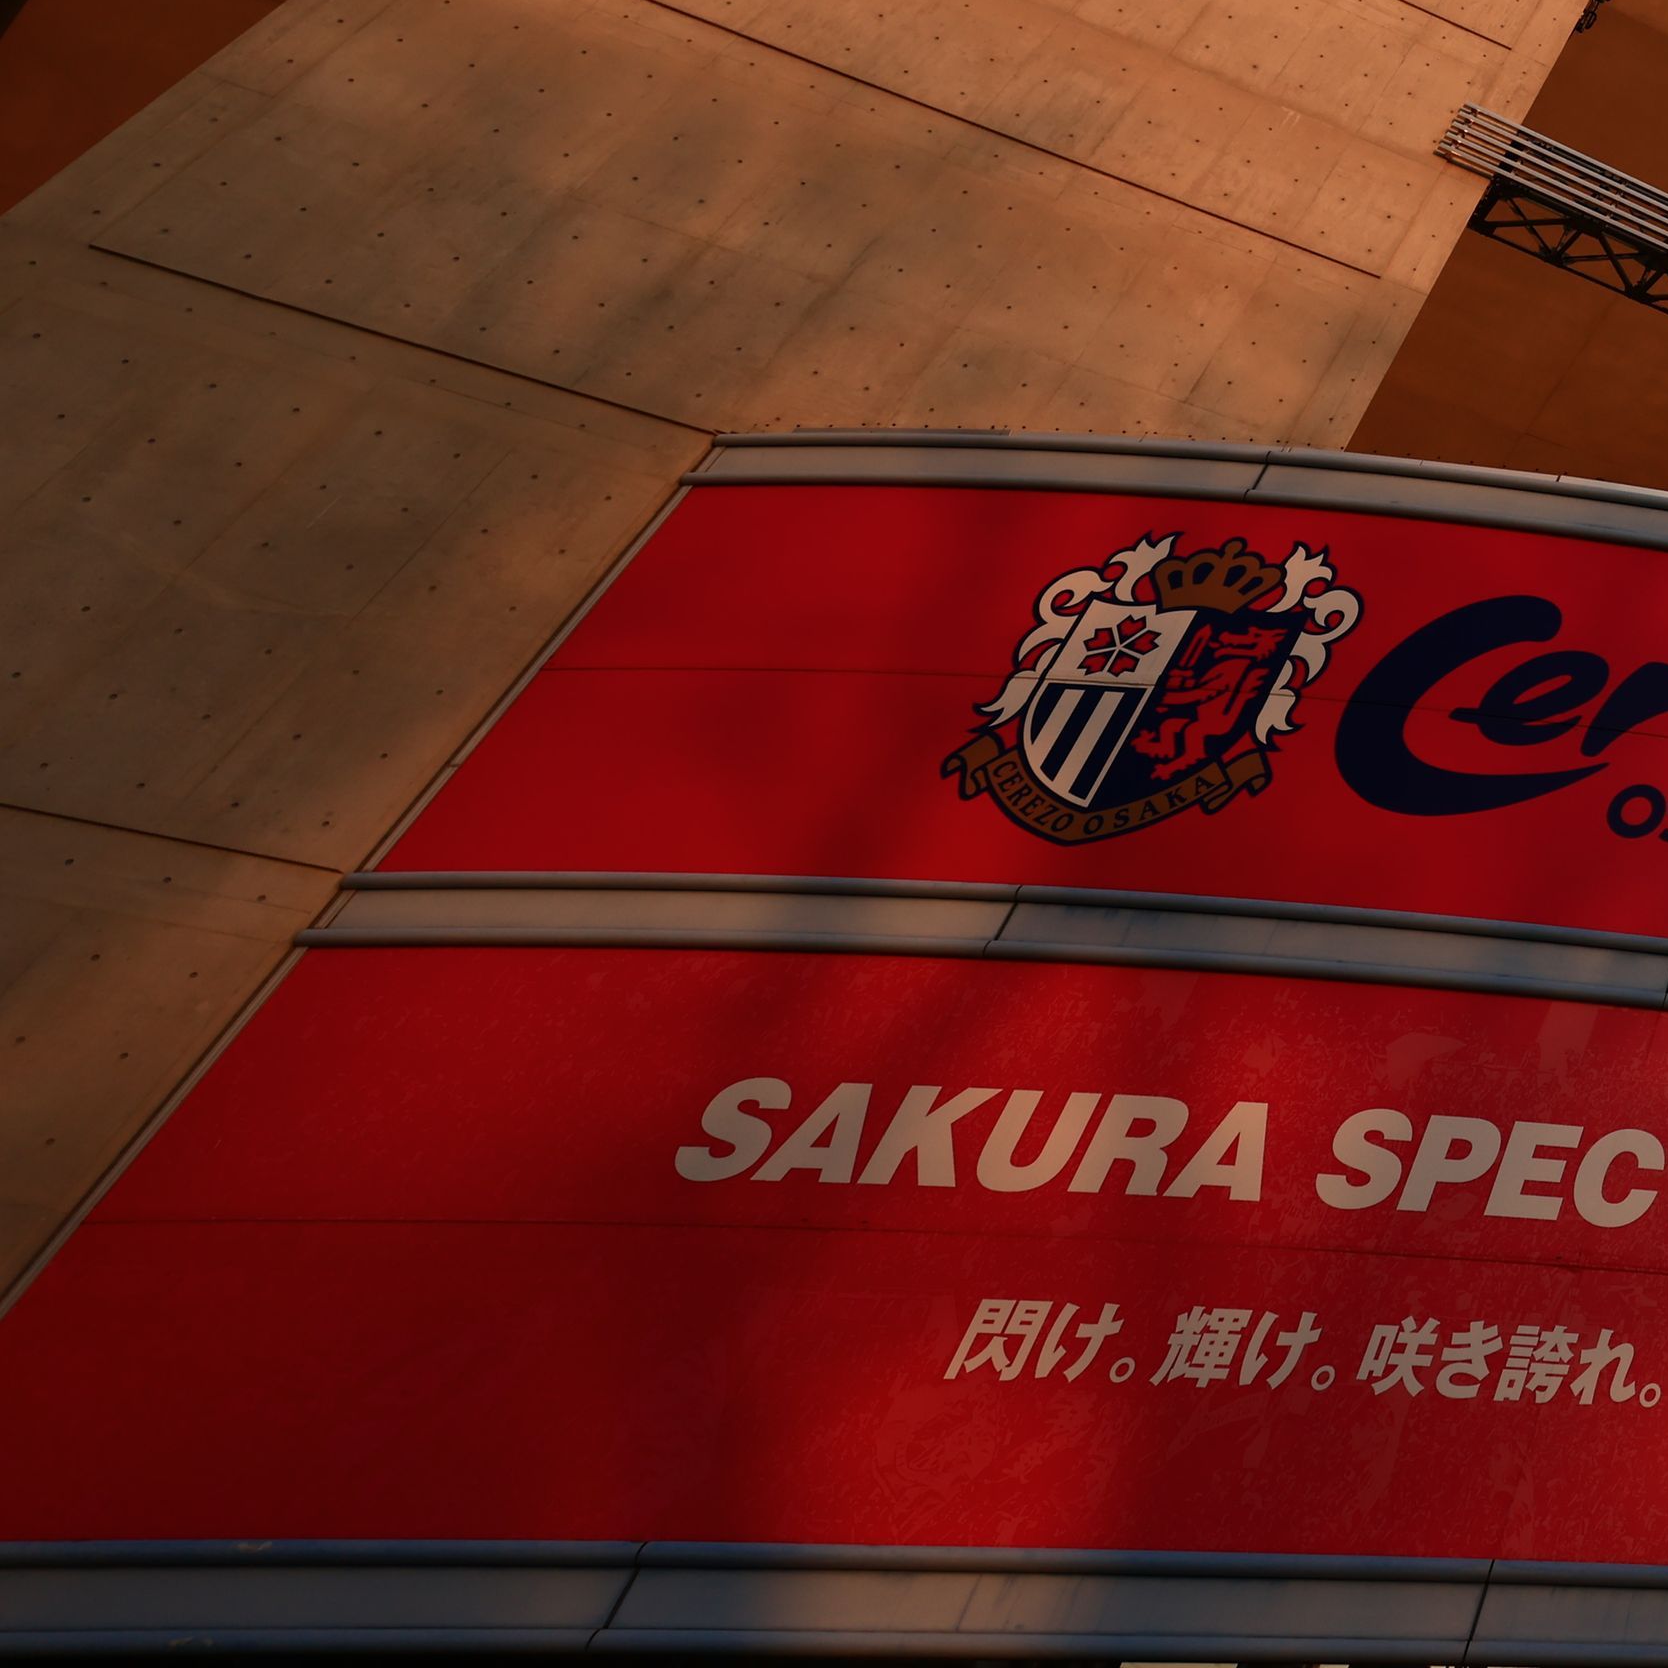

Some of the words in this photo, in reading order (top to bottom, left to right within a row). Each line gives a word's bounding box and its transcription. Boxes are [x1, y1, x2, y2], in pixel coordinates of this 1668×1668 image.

[993, 759, 1074, 834] CEREZO
[1083, 775, 1216, 835] OSAKA
[673, 1076, 1271, 1202] SAKURA
